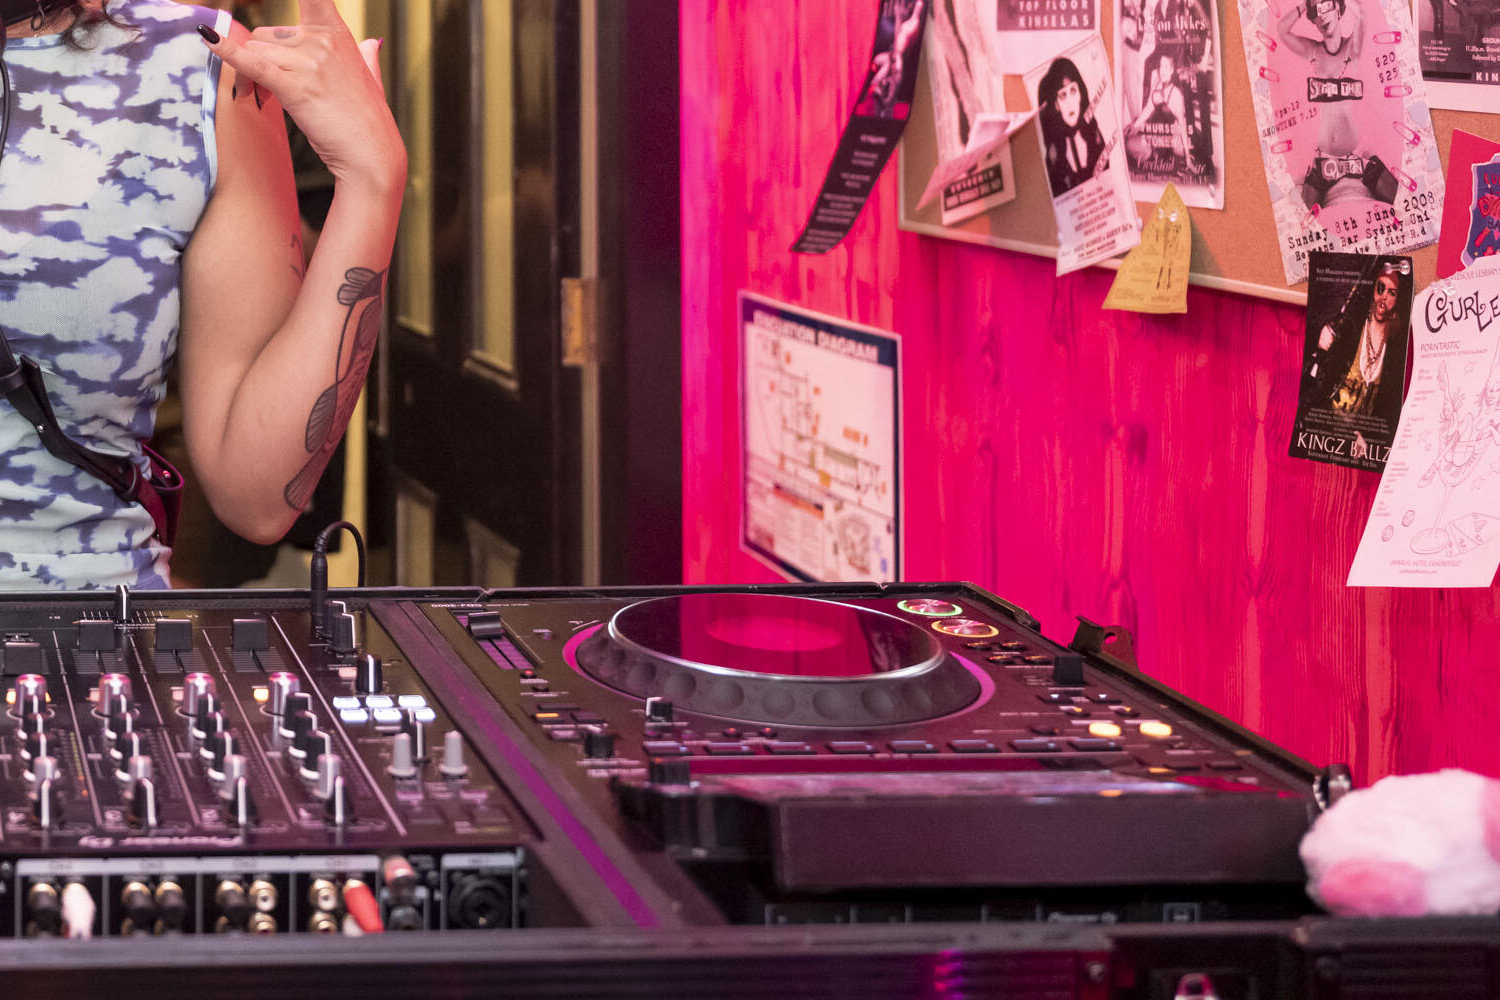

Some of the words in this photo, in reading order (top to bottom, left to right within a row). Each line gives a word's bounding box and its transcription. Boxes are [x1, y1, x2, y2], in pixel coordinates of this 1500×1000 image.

[1018, 0, 1040, 13] TOP
[1018, 13, 1090, 29] KINSELAS
[1375, 51, 1396, 68] $20
[1379, 68, 1399, 83] $25
[1476, 72, 1499, 82] KIN
[1141, 123, 1194, 136] THURSDS
[1288, 227, 1328, 249] Sunday
[1335, 216, 1358, 235] 8th
[1365, 206, 1396, 225] June
[1404, 191, 1435, 213] 2008
[1341, 234, 1359, 248] Bar
[1366, 220, 1405, 240] Sydney
[1410, 213, 1431, 226] Uni
[1385, 234, 1405, 248] City
[1420, 341, 1461, 353] PORNTASTIC
[1297, 431, 1345, 455] KINGZ
[1350, 440, 1393, 463] BALLZ
